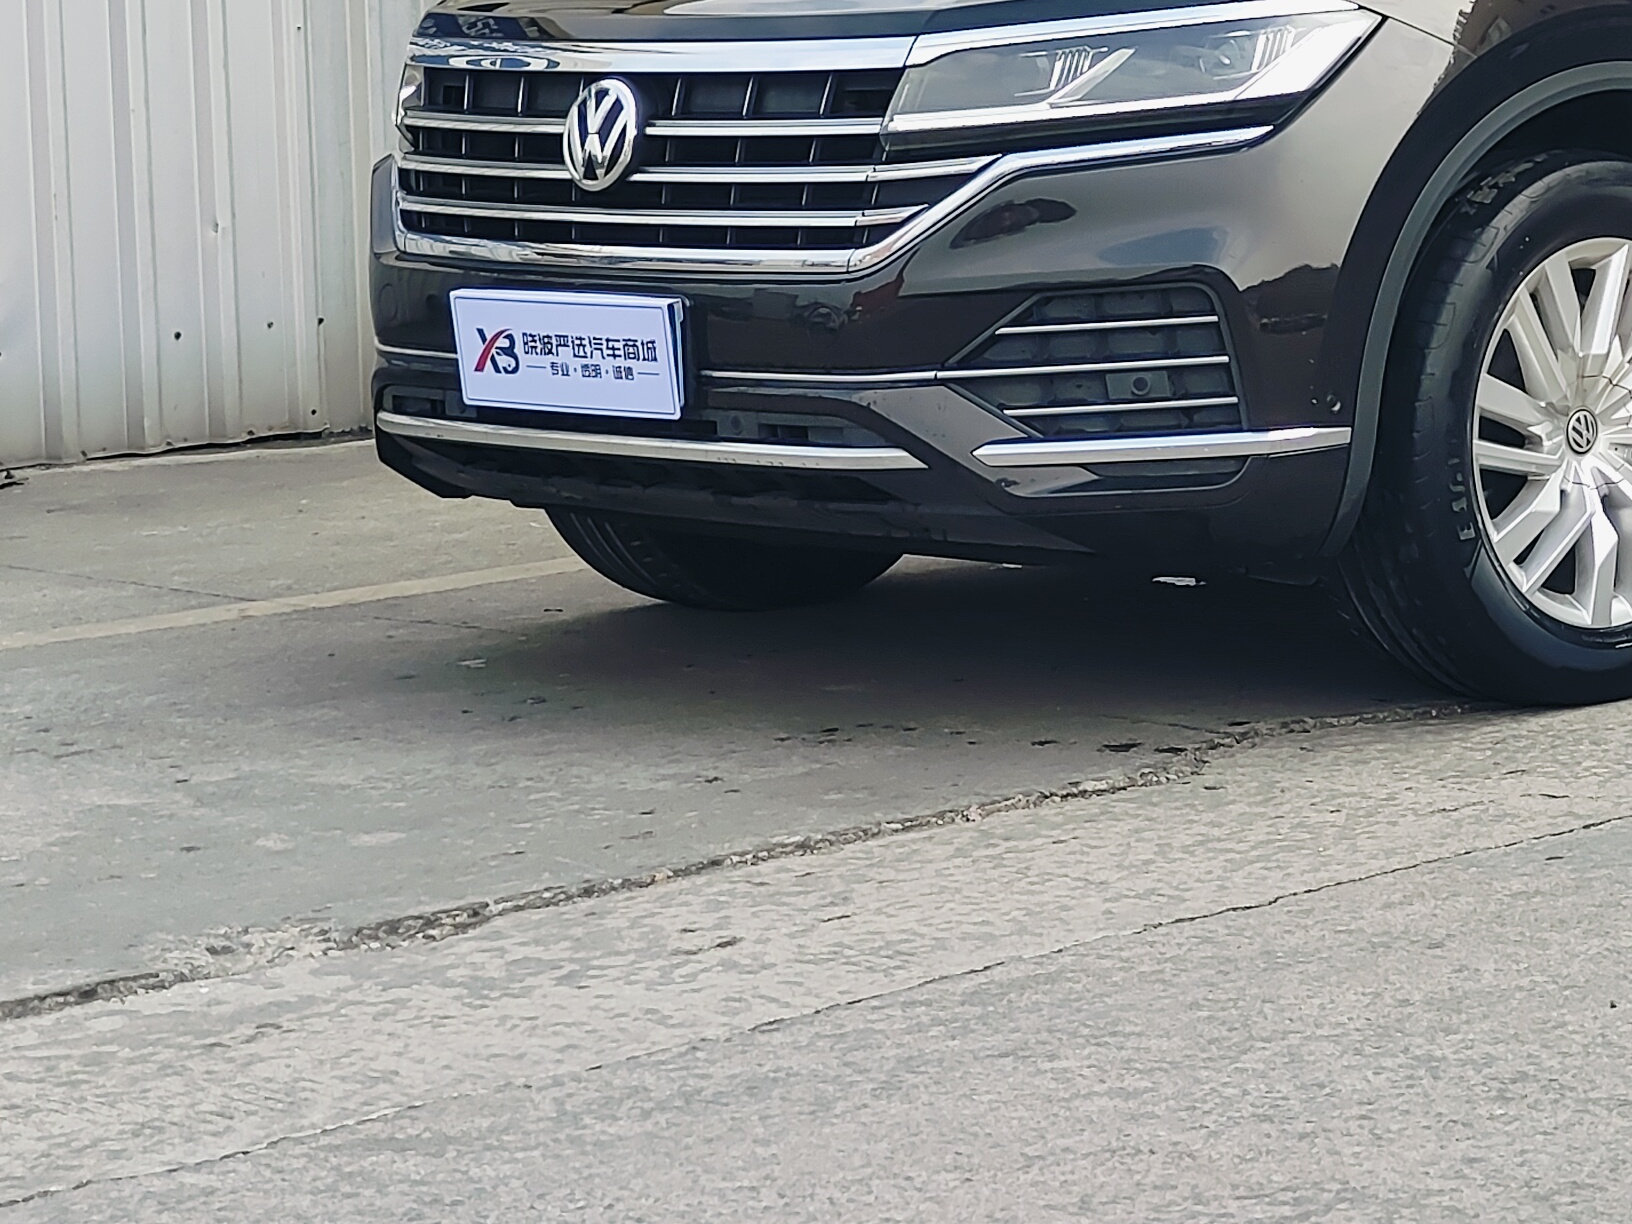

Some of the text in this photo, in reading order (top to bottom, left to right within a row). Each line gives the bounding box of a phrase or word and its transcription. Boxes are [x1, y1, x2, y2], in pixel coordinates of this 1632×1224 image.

[522, 331, 658, 363] 晓波严选汽车商城
